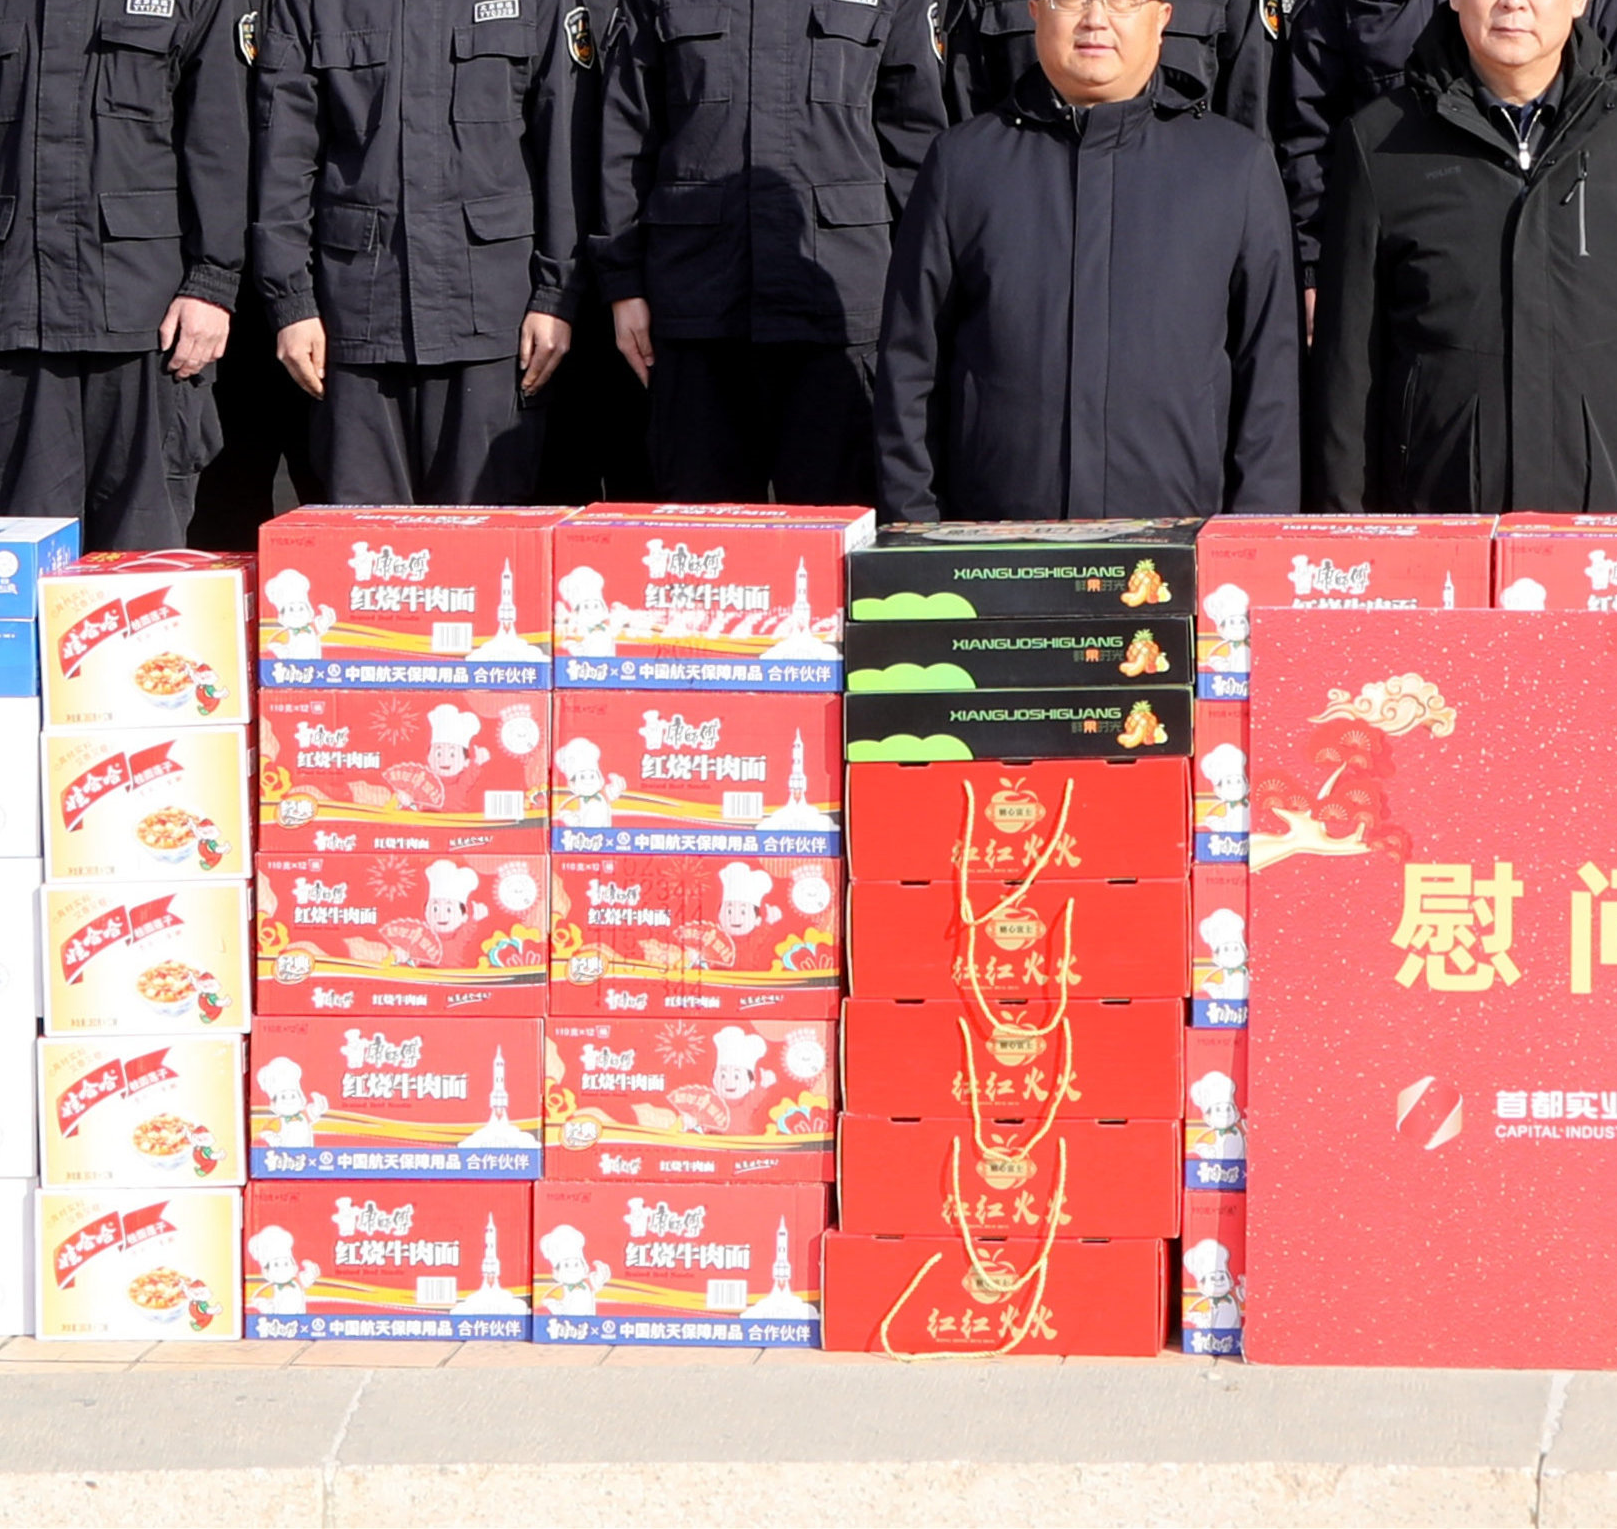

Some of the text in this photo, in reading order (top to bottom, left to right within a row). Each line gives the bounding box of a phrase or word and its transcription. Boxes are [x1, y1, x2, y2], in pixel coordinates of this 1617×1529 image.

[953, 565, 1126, 581] XIANGUOSHIGUANG
[349, 585, 476, 613] 红烧牛肉面
[644, 583, 771, 611] 红烧牛肉面
[951, 635, 1124, 651] XIANGUOSHIGUANG
[345, 666, 469, 684] 中国航天保障用品
[639, 664, 763, 682] 中国航天保障用品
[949, 707, 1122, 723] XIANGUOSHIGUANG
[640, 754, 767, 782] 红烧牛肉面
[635, 834, 759, 852] 中国航天保障用品
[341, 1072, 468, 1100] 红烧牛肉面
[1495, 1125, 1561, 1139] CAPITAL
[337, 1153, 461, 1171] 中国航天保障用品
[334, 1239, 461, 1267] 红烧牛肉面
[624, 1242, 751, 1270] 红烧牛肉面
[331, 1319, 452, 1336] 中国航天保障用品
[619, 1323, 743, 1341] 中国航天保障用品
